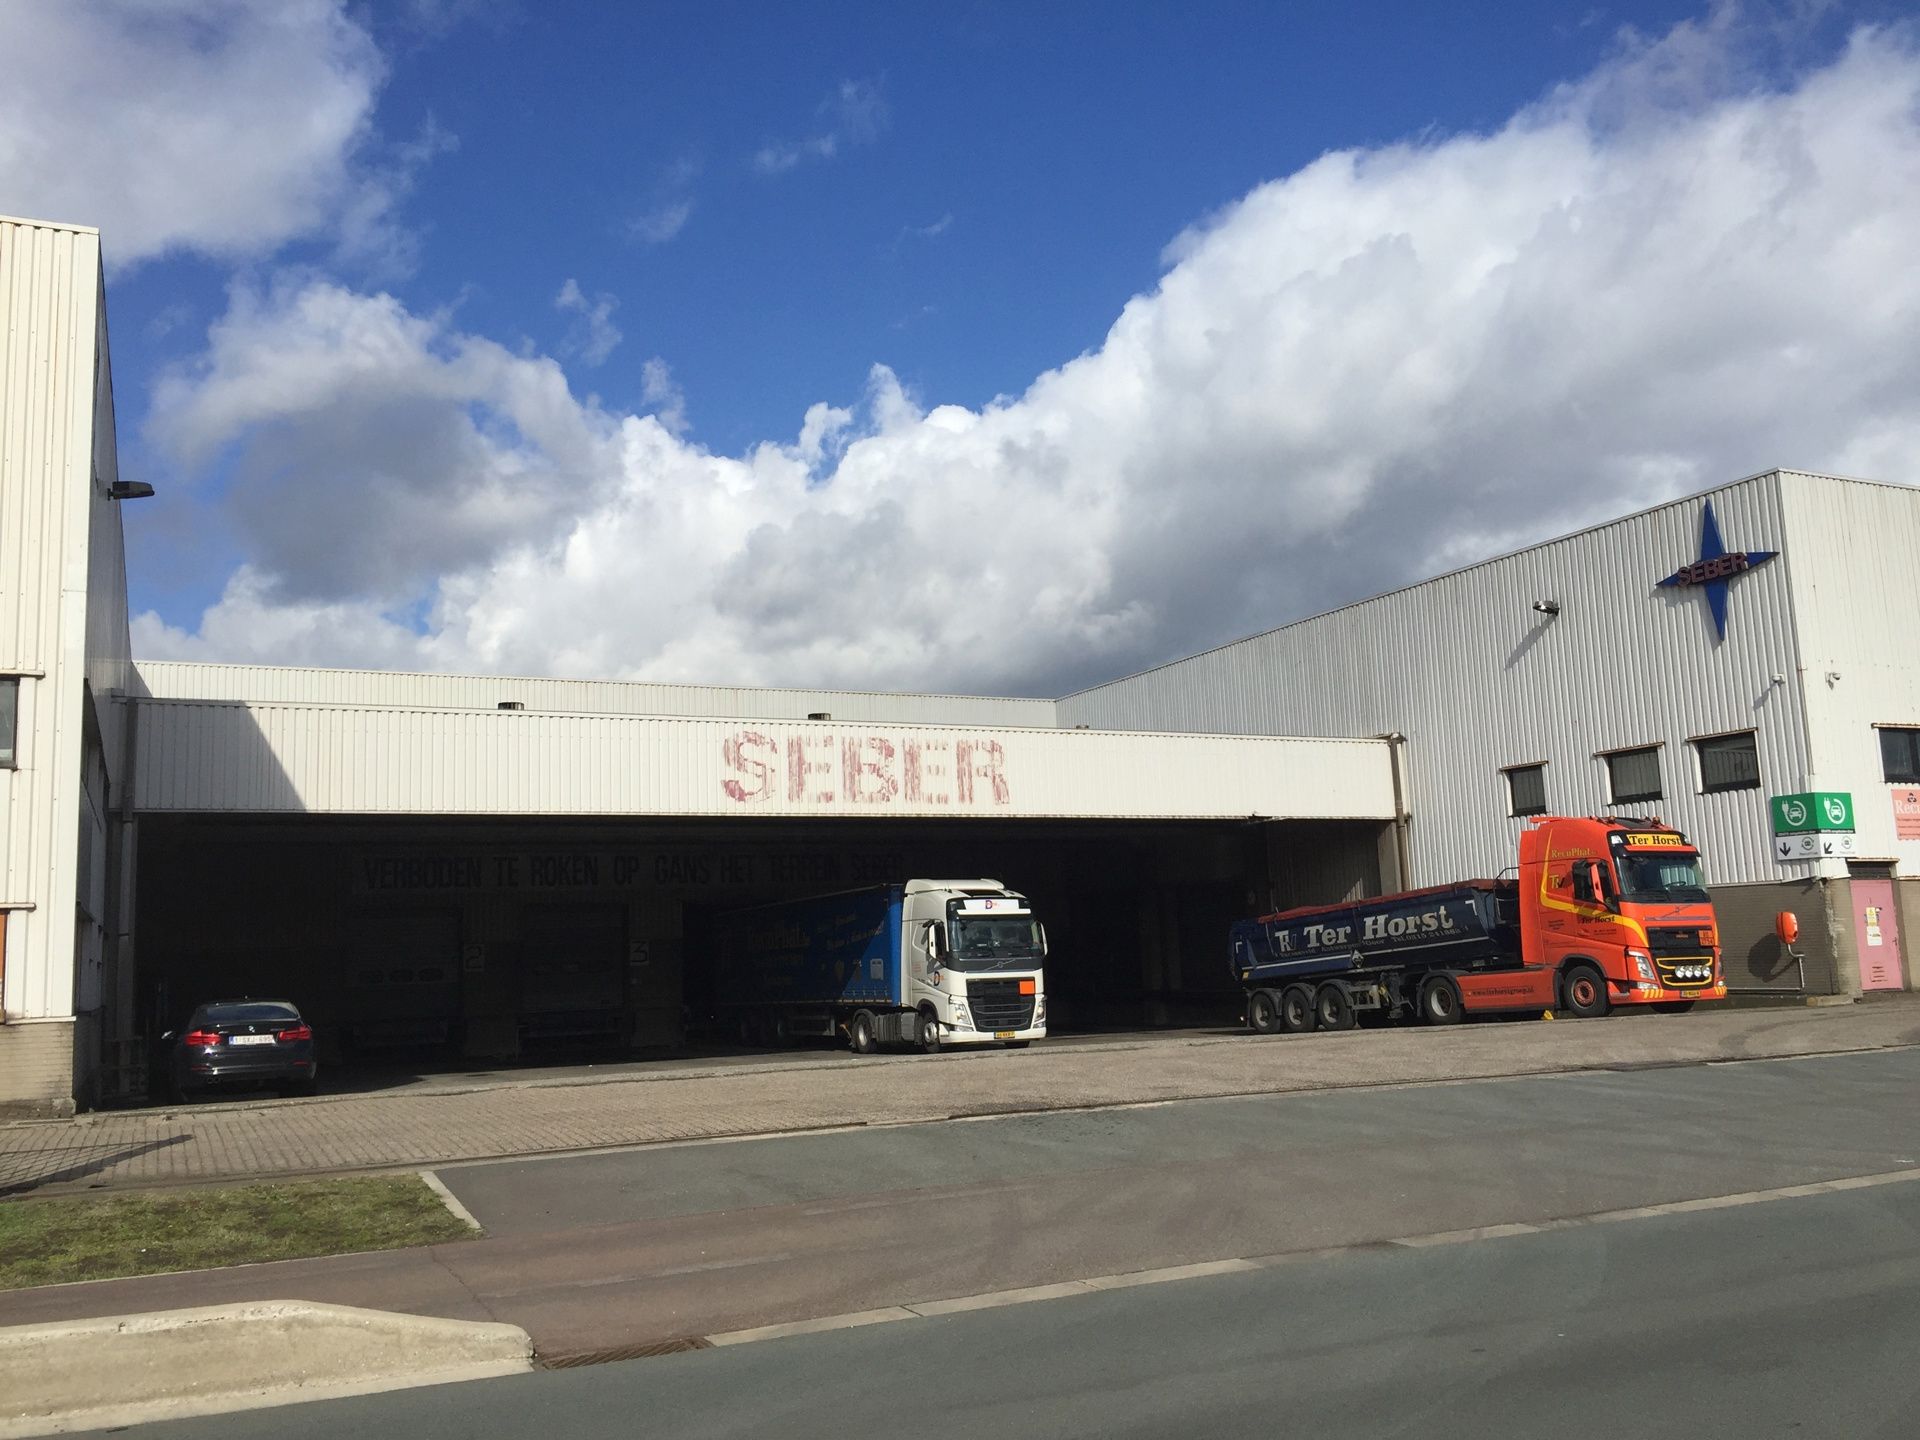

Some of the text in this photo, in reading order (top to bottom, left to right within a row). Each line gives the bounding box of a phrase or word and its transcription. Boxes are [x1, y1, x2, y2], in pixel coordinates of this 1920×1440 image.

[1678, 552, 1748, 587] SEBER
[722, 732, 1010, 804] SEBER
[1630, 835, 1681, 846] Ter Horst
[364, 857, 482, 888] VERBODEN
[493, 856, 518, 887] TE
[532, 856, 598, 886] ROKEN
[613, 855, 640, 885] OP
[655, 855, 711, 885] GANS
[720, 854, 753, 884] HET
[1303, 924, 1351, 948] Ter
[1363, 905, 1454, 940] Horst
[465, 946, 482, 969] 2
[632, 941, 648, 962] 3
